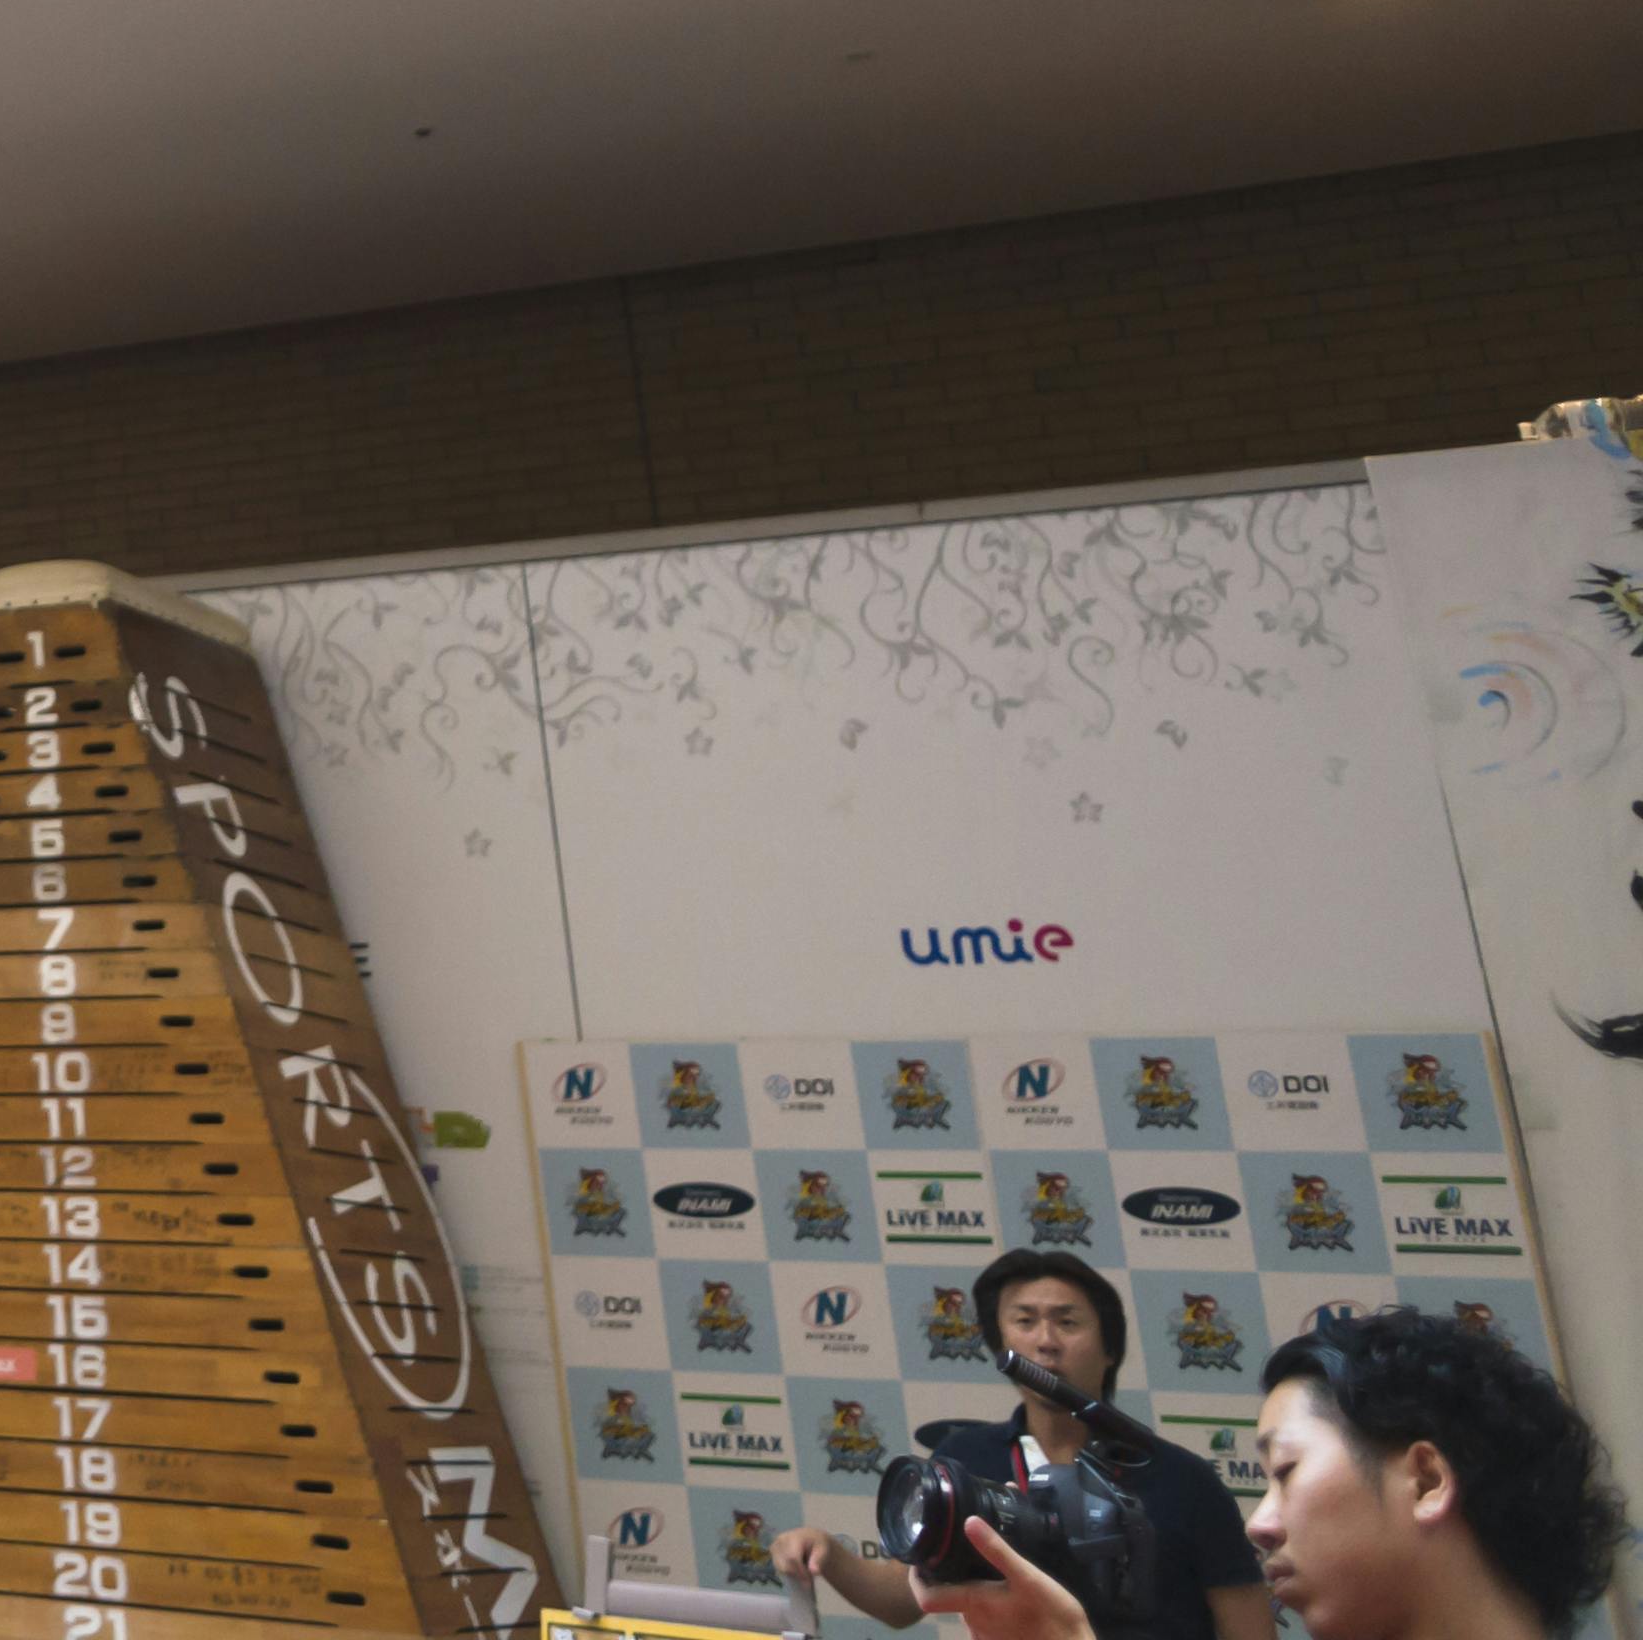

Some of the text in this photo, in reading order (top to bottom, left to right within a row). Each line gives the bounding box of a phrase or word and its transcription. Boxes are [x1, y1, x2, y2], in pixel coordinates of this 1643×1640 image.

[26, 630, 45, 668] 1
[24, 686, 59, 726] 2
[26, 730, 60, 769] 3
[26, 775, 62, 809] 4
[31, 818, 64, 858] 5
[36, 907, 75, 951] 7
[900, 917, 1075, 965] umie
[38, 954, 76, 997] 8
[41, 1002, 76, 1044] 9
[30, 1051, 91, 1092] 10
[794, 1078, 835, 1097] DOI
[1282, 1075, 1330, 1094] DOI
[41, 1098, 86, 1139] 11
[38, 1146, 97, 1188] 12
[40, 1195, 101, 1239] 13
[937, 1208, 986, 1229] MAX
[1150, 1203, 1213, 1220] INAMI
[1454, 1217, 1514, 1238] MAX
[42, 1244, 102, 1288] 14
[46, 1295, 109, 1340] 15
[603, 1296, 642, 1315] DOI
[51, 1396, 114, 1442] 17
[736, 1433, 784, 1453] MAX
[53, 1445, 117, 1493] 18
[59, 1500, 123, 1547] 19
[52, 1551, 128, 1601] 20
[62, 1604, 128, 1640] 21
